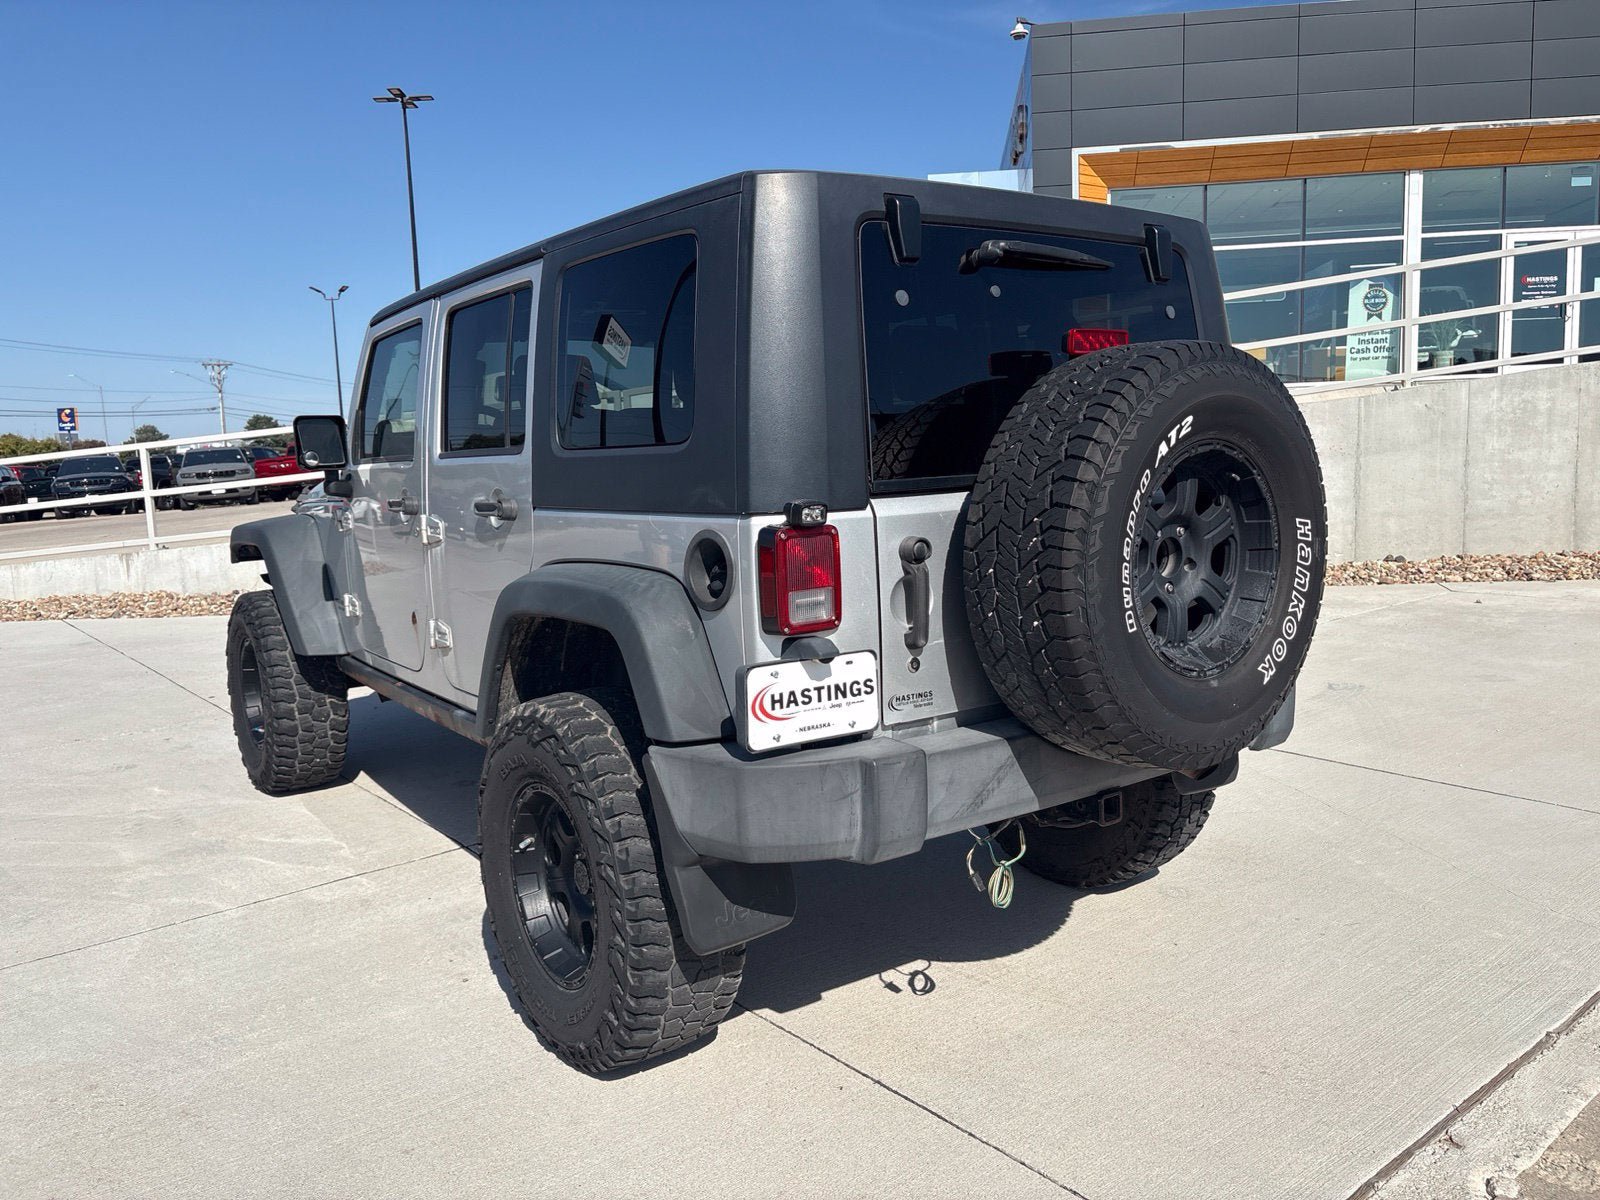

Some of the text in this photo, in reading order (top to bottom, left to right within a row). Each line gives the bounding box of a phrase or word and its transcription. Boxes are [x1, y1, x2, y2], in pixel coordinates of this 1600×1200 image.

[1526, 275, 1558, 283] HASTINGS
[1357, 337, 1388, 345] Instant
[1349, 344, 1396, 355] Cash Offer
[1155, 415, 1194, 468] AT2
[770, 678, 875, 711] HASTINGS
[895, 690, 933, 702] HASTINGS
[799, 722, 831, 733] NEBRASKA
